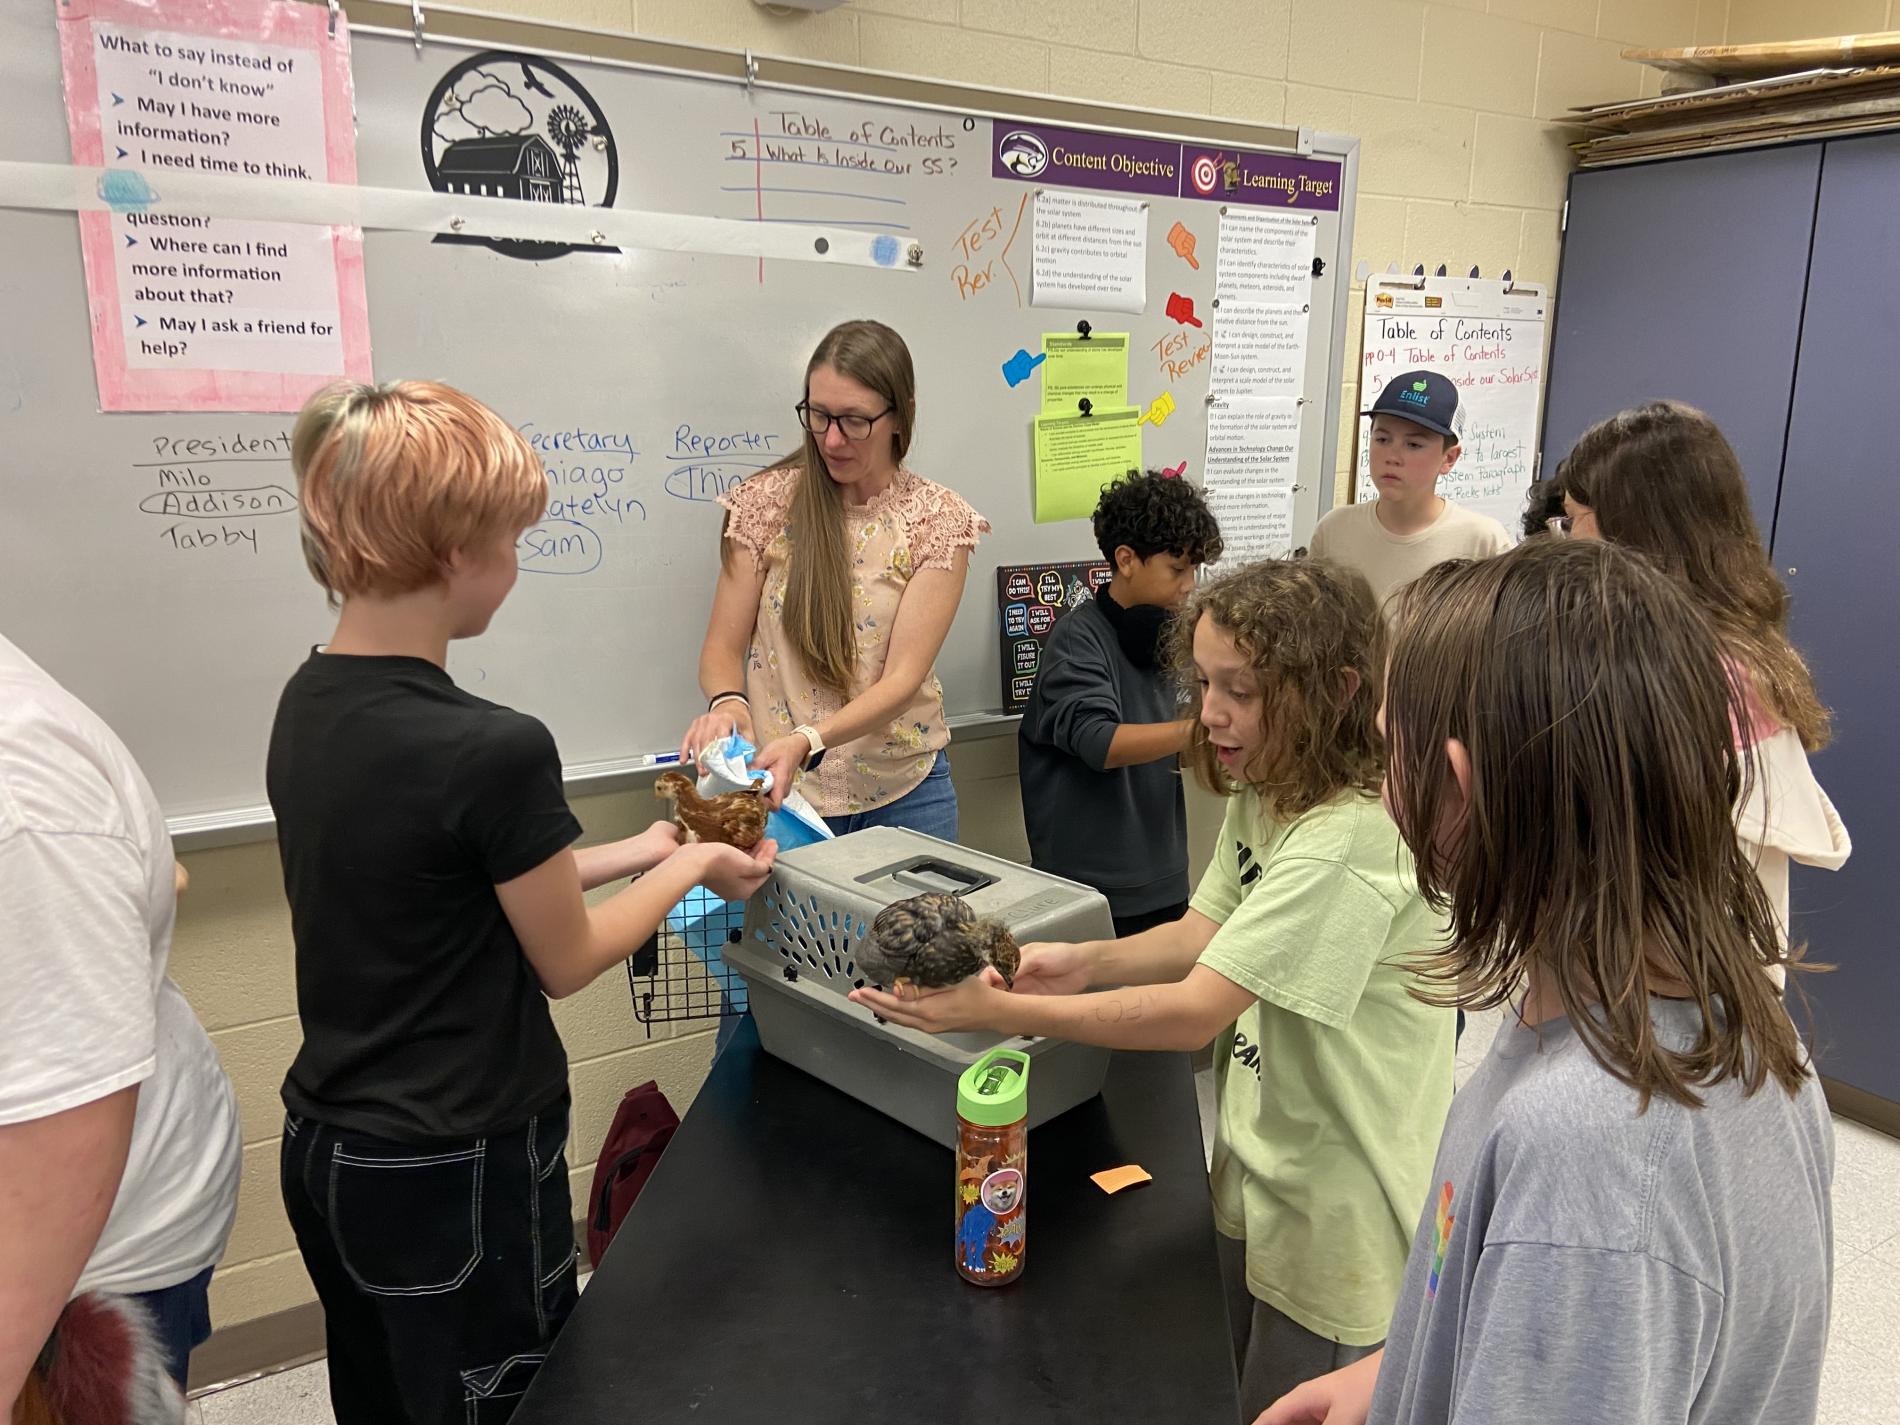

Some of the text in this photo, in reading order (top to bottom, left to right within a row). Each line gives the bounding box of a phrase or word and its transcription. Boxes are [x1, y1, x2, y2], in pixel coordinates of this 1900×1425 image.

[99, 34, 294, 74] What to say instead of
[137, 97, 280, 127] May I have more
[117, 120, 230, 146] information?
[769, 111, 955, 149] Table of Contents
[141, 149, 312, 181] I need time to think.
[731, 140, 747, 160] 5
[766, 144, 804, 163] What
[836, 149, 876, 170] Inside
[1052, 147, 1175, 178] Content Objective
[1243, 169, 1333, 194] Learning Target
[951, 206, 1002, 260] Test
[150, 236, 287, 258] Where can I find
[132, 263, 281, 282] more information
[134, 287, 234, 304] about that?
[159, 316, 333, 337] May I ask a friend for
[1377, 317, 1512, 341] Table of Contents
[141, 339, 188, 357] help?
[1151, 331, 1188, 361] Test
[1403, 347, 1436, 364] Table
[1444, 344, 1458, 362] of
[1464, 343, 1506, 360] Contents
[1372, 374, 1383, 393] 5
[1450, 371, 1475, 386] nside
[1400, 390, 1429, 404] Enlist
[152, 431, 293, 457] President
[675, 424, 779, 457] Reporter
[159, 468, 211, 487] Milo
[163, 491, 282, 515] Addison
[160, 522, 258, 554] Tabby
[522, 529, 585, 562] Sam
